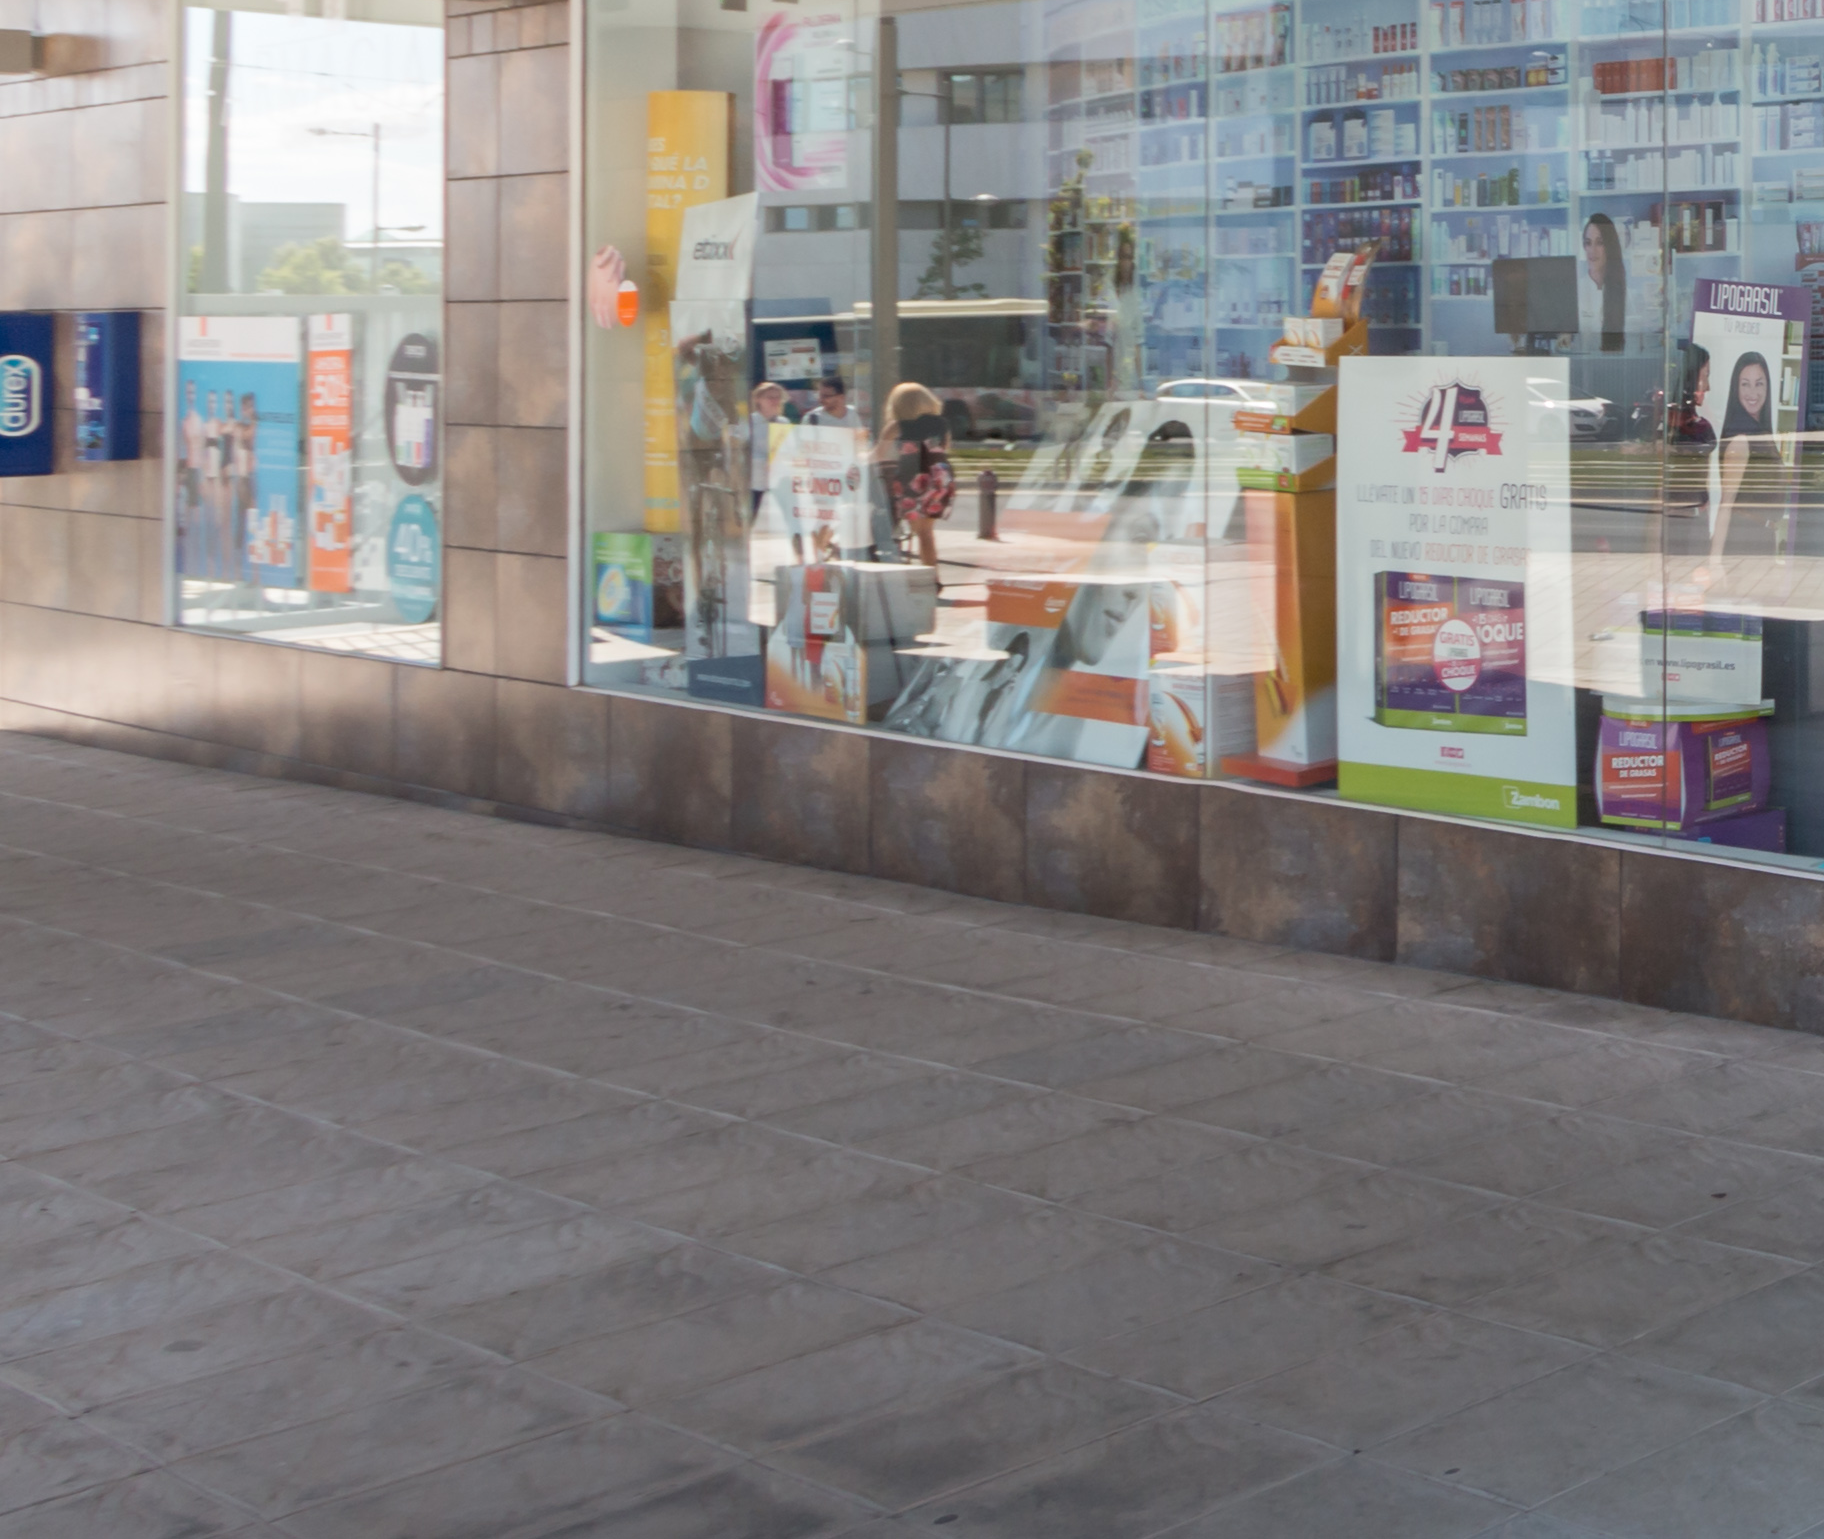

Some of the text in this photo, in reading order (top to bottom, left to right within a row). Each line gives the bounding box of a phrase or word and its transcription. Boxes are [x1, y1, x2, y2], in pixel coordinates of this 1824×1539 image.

[2, 364, 28, 428] durex
[1501, 482, 1548, 511] GRATIS
[1408, 513, 1489, 536] POR LA COMPRA
[1391, 541, 1421, 560] NUEVO
[1424, 542, 1474, 564] REDUCTOR
[1478, 545, 1489, 565] DE
[1390, 607, 1449, 626] REDUCTOR
[1439, 630, 1476, 648] GRATIS
[1440, 663, 1477, 679] CHOQUE
[1611, 754, 1665, 770] REDUCTOR
[1618, 767, 1658, 778] DE GRASAS
[1510, 789, 1561, 811] Zambon
